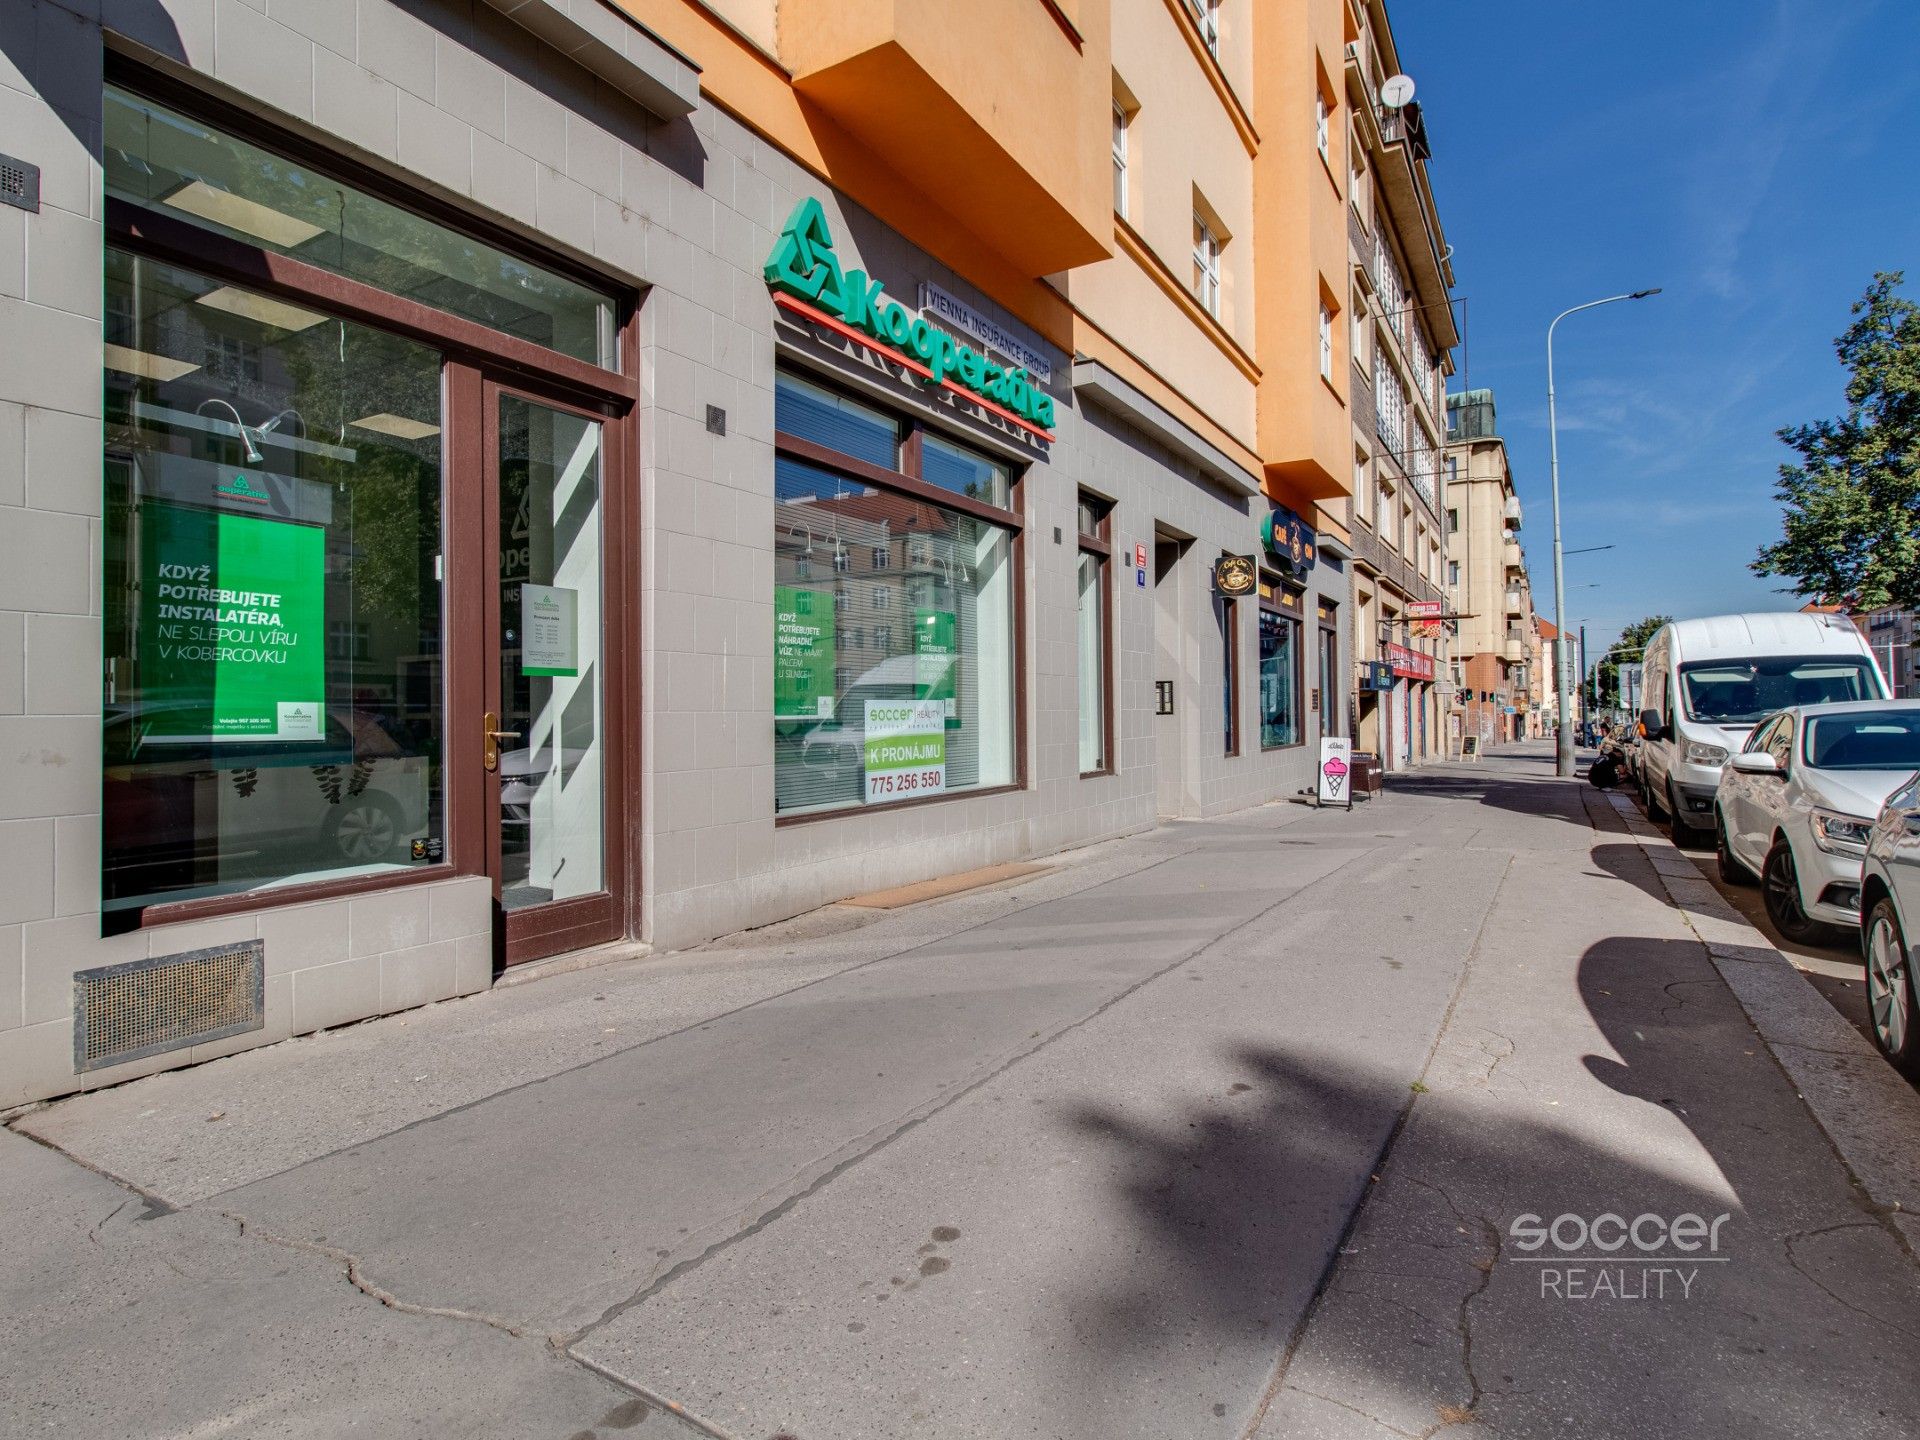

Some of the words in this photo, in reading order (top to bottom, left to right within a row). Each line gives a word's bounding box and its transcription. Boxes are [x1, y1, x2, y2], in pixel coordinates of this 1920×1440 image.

[929, 288, 969, 328] VIENNA
[971, 315, 1021, 360] INSURANCE
[1023, 350, 1050, 376] GROUP
[845, 269, 1056, 429] Kooperativa
[158, 563, 211, 582] KDYŽ
[158, 583, 282, 608] POTŘEBUJETE
[158, 604, 284, 628] INSTALATÉRA,
[778, 612, 797, 623] KDYŽ
[158, 624, 183, 640] NE
[189, 626, 254, 643] SLEPOU
[259, 629, 297, 646] VÍRU
[778, 623, 821, 636] POTŘEBUJETE
[159, 645, 172, 659] V
[176, 645, 287, 664] KOBERCOVKU
[870, 708, 914, 721] soccer
[870, 748, 879, 764] K
[881, 742, 940, 763] PRONÁJMU
[871, 775, 893, 795] 775
[896, 773, 918, 792] 256
[921, 770, 941, 788] 550
